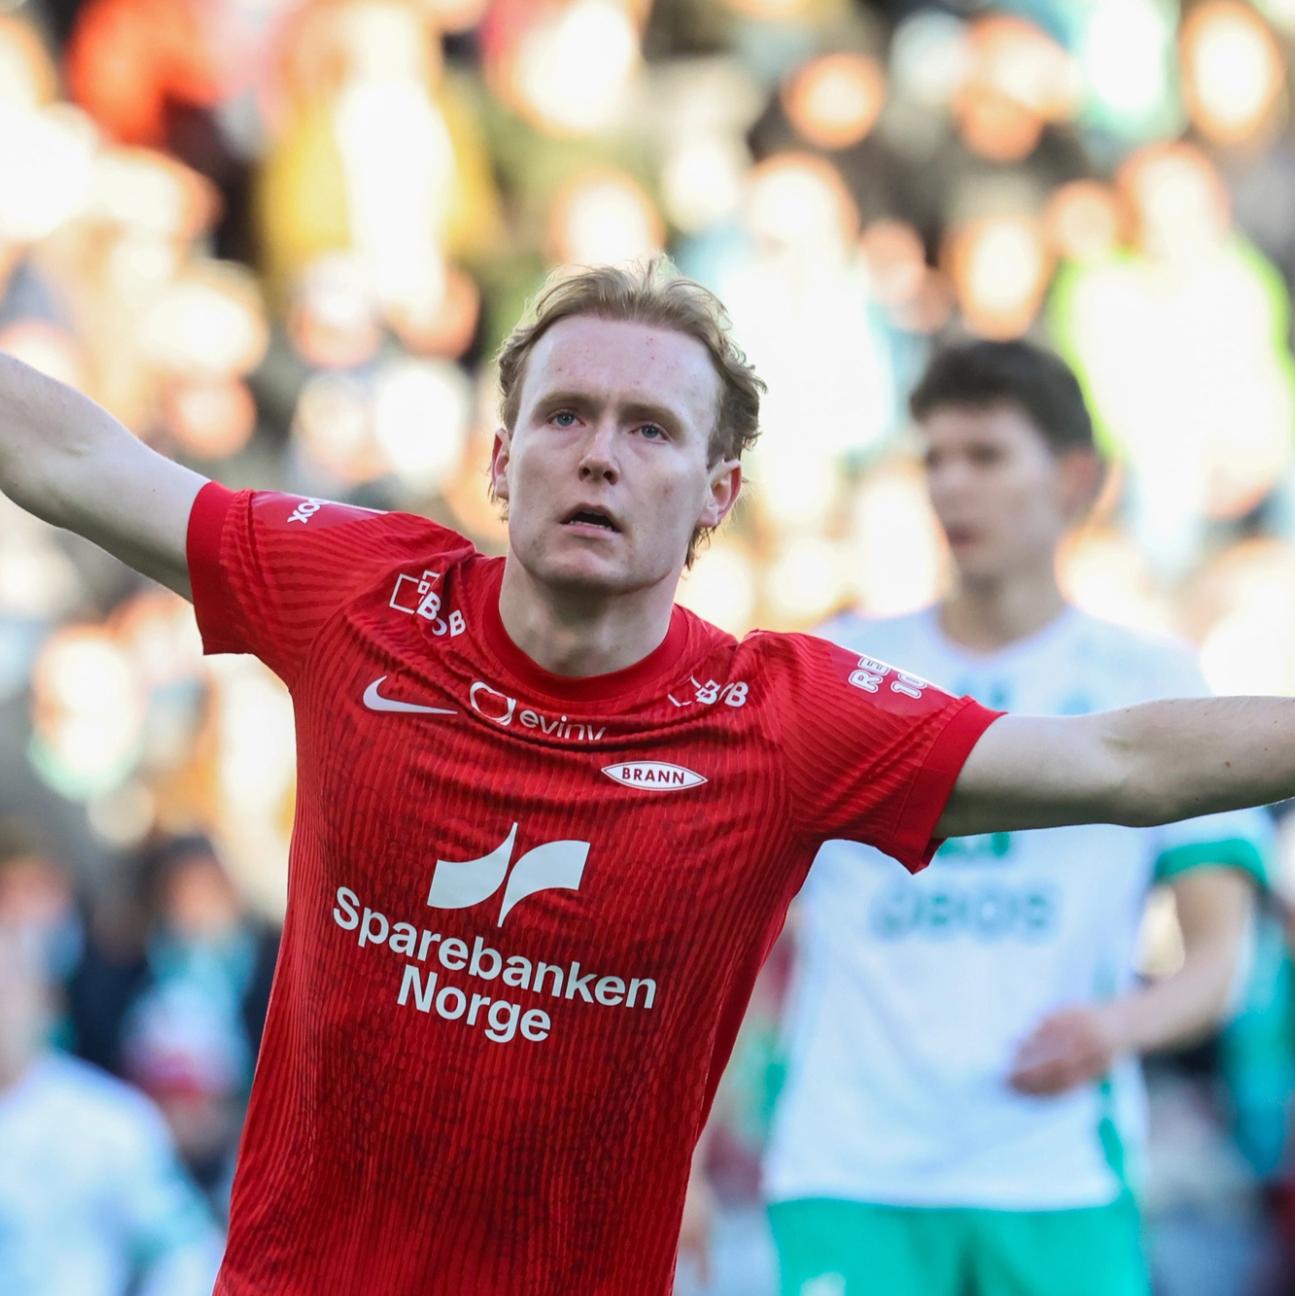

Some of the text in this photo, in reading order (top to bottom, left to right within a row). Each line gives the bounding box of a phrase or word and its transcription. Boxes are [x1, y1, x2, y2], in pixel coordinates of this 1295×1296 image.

[621, 767, 685, 785] BRANN
[333, 886, 657, 1009] Sparebanken
[397, 965, 551, 1043] Norge
